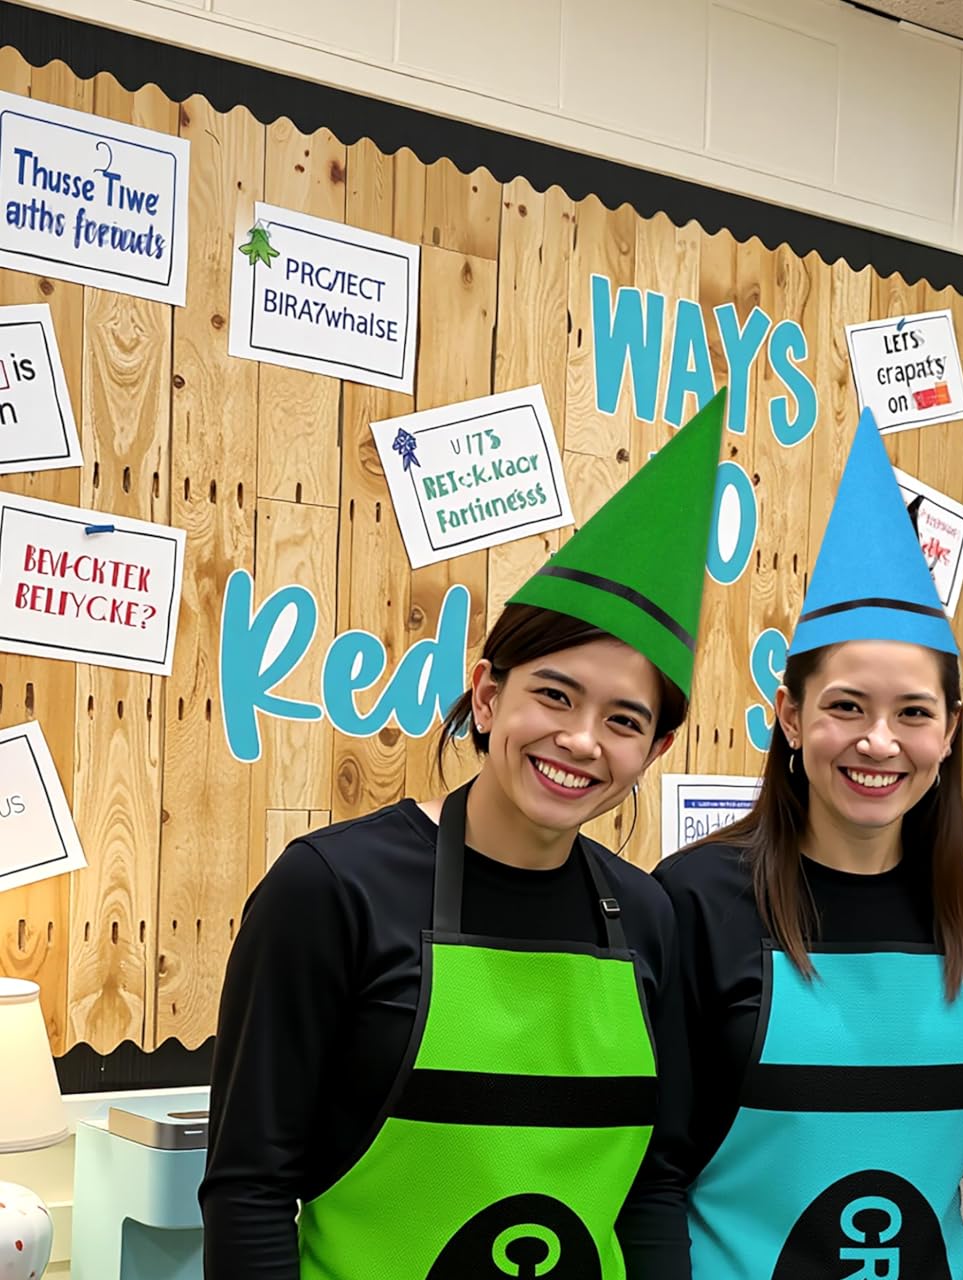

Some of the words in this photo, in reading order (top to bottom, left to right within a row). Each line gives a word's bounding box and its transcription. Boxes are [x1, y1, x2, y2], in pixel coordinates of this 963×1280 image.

[10, 353, 36, 381] is
[590, 273, 818, 448] WAYS
[888, 395, 909, 414] on
[219, 568, 471, 764] Red
